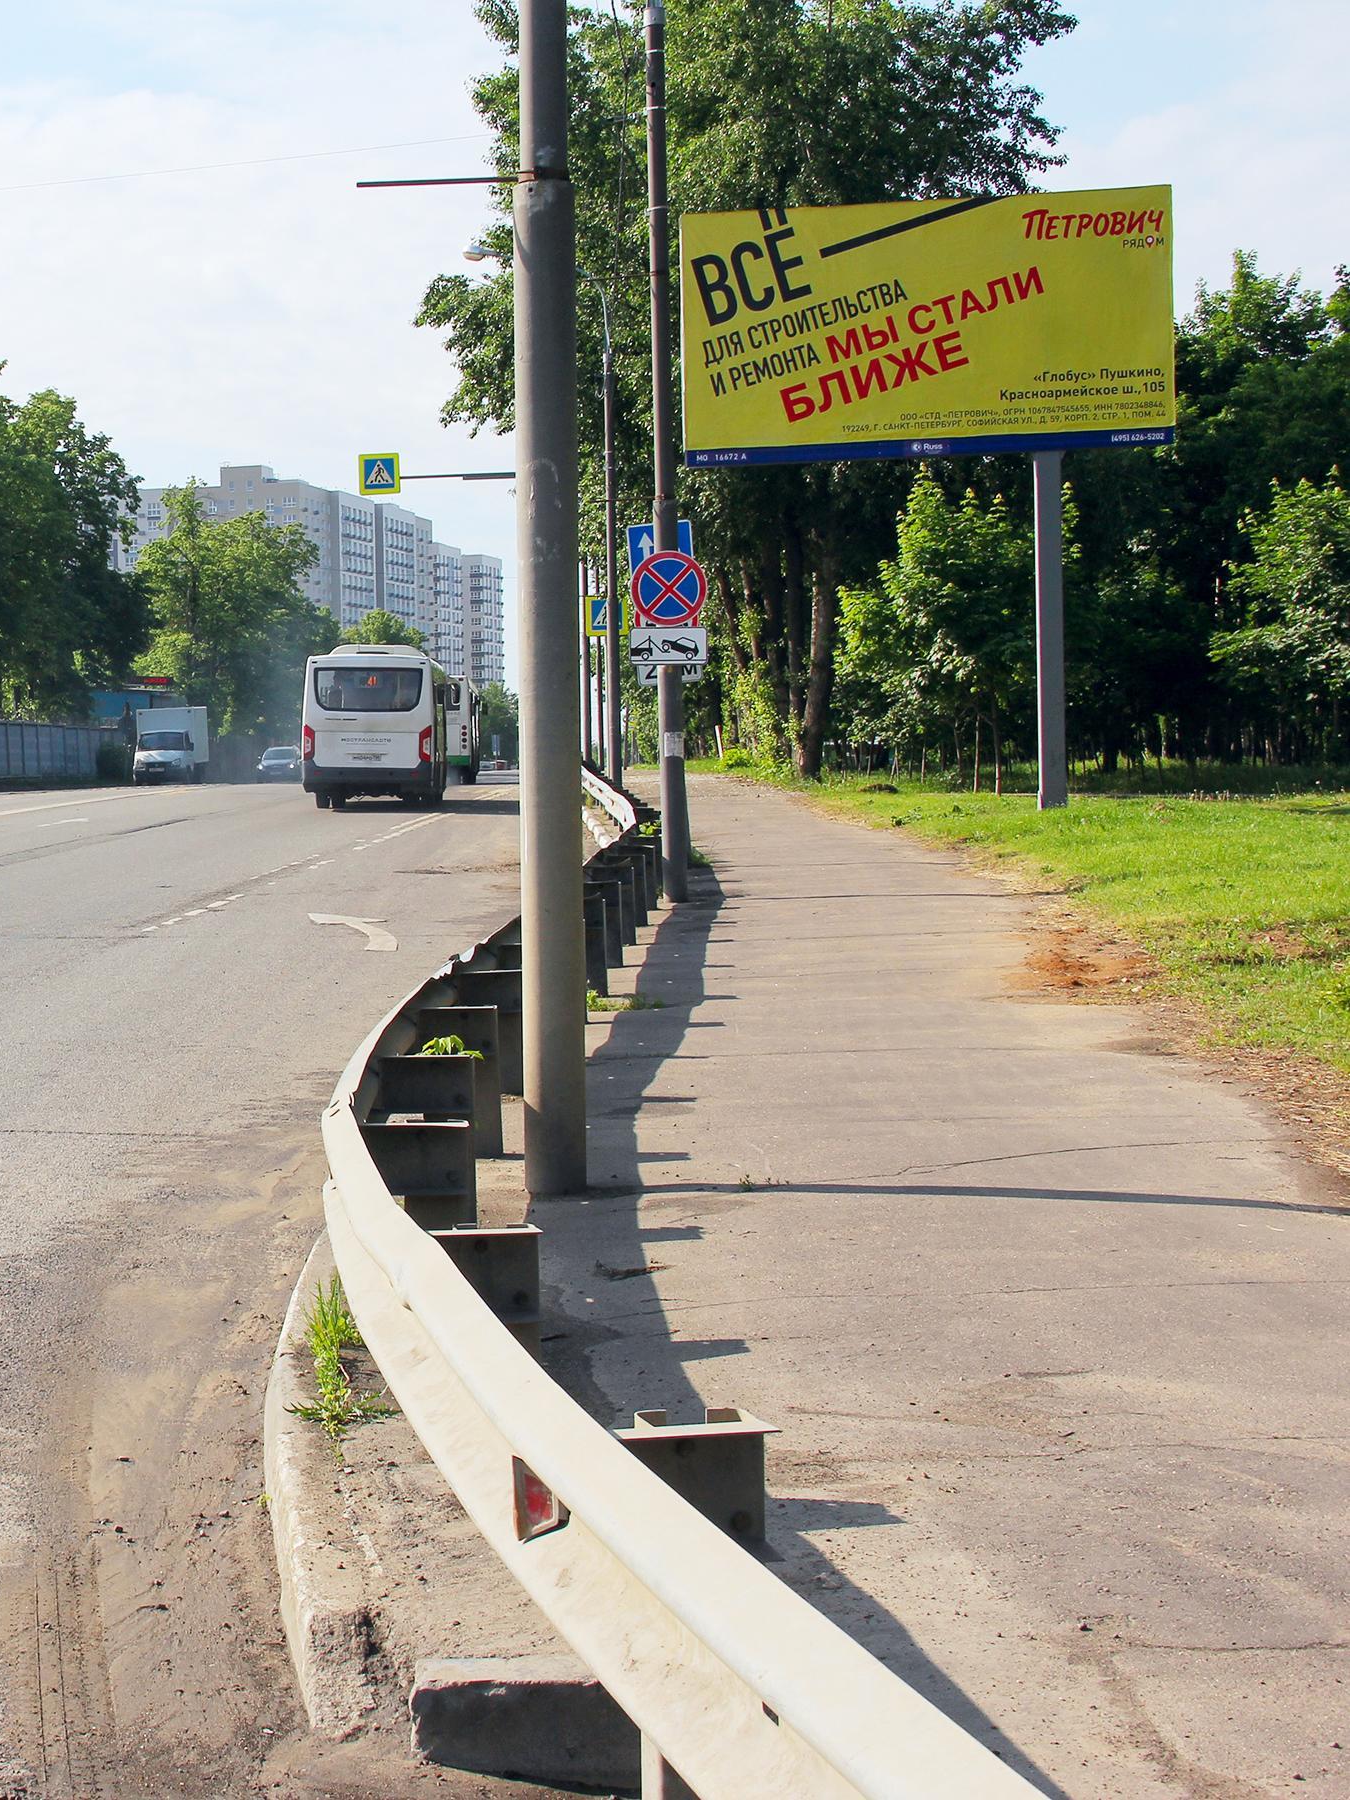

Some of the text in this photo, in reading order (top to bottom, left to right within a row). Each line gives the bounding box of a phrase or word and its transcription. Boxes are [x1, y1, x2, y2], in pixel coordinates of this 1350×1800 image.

[1021, 208, 1164, 240] ПЕТРОВИЧ
[690, 208, 812, 327] ВСЁ
[702, 279, 908, 369] ДЛЯ СТРОИТЕЛЬСТВА
[825, 266, 1045, 364] МЫ СТАЛИ
[710, 342, 821, 397] И РЕМОНТА
[779, 330, 970, 424] БЛИЖЕ
[1033, 368, 1165, 383] «Глобус» Пушкино,
[1000, 386, 1118, 402] Красноармейское
[900, 413, 917, 421] ООО
[1003, 408, 1025, 416] ОГРН
[1094, 403, 1113, 411] ИНН
[966, 417, 1019, 427] СОФИЙСКАЯ
[923, 442, 943, 451] Russ
